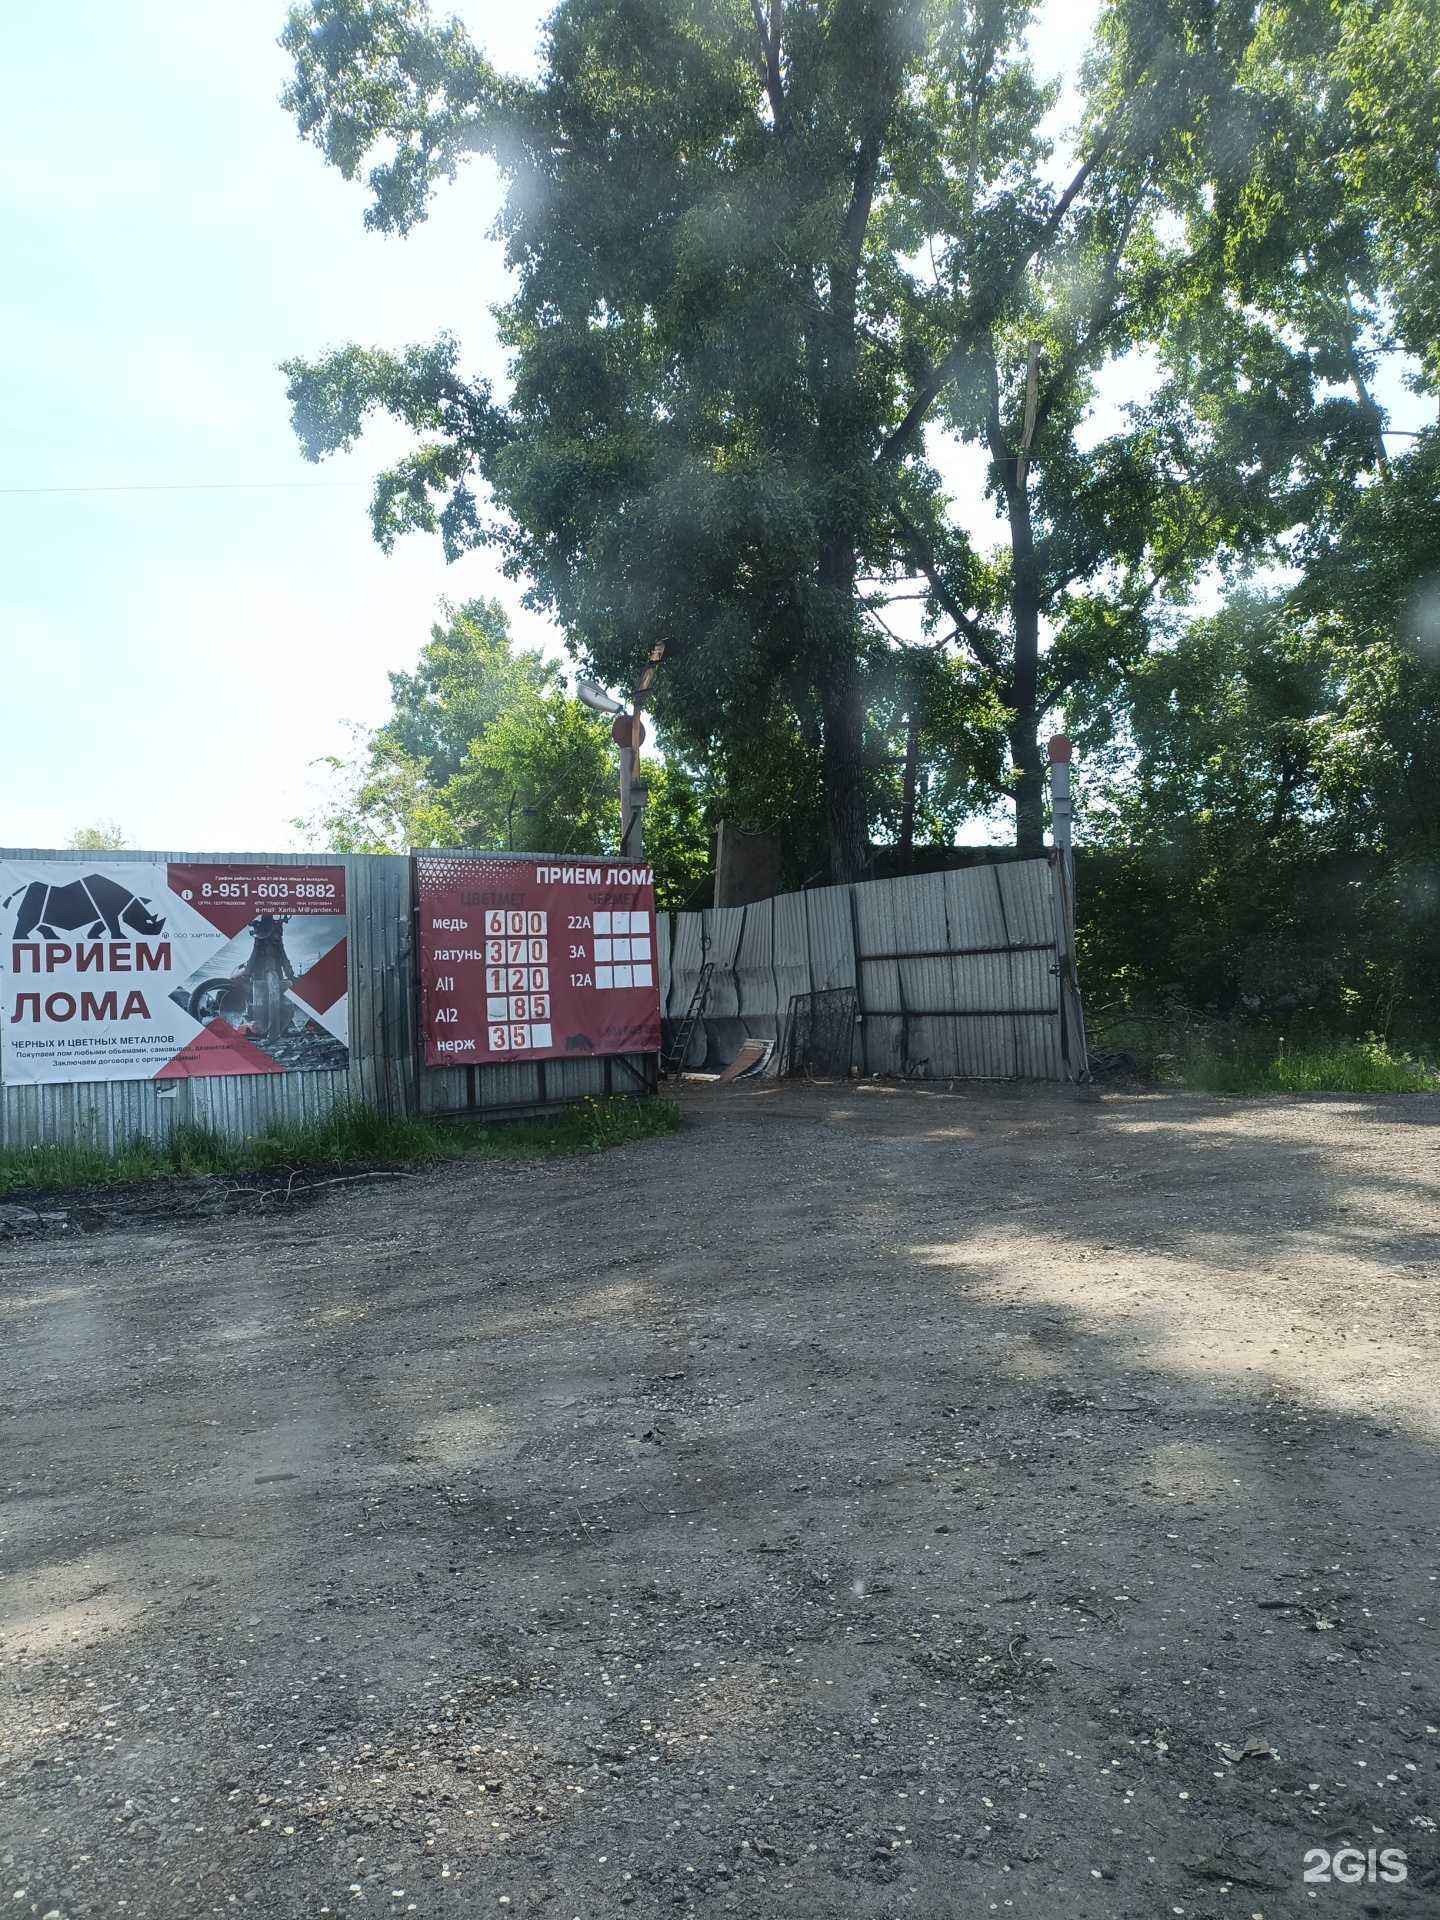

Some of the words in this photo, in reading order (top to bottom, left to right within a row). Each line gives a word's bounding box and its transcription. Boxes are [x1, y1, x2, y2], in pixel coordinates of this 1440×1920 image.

[536, 866, 601, 885] ПРИЕМ
[201, 883, 336, 898] 8-951-603-8882
[432, 918, 468, 932] медь
[490, 912, 542, 933] 600
[567, 916, 591, 929] 22А
[12, 942, 172, 973] ПРИЕМ
[433, 949, 482, 962] латунь
[490, 941, 543, 962] 370
[569, 945, 586, 958] 3А
[491, 969, 544, 991] 120
[569, 974, 592, 987] 12А
[11, 990, 152, 1023] ЛОМА
[514, 997, 546, 1018] 85
[11, 1039, 55, 1048] ЧЕРНЫХ
[57, 1039, 65, 1047] И
[67, 1038, 117, 1047] ЦВЕТНЫХ
[120, 1035, 174, 1044] МЕТАЛЛОВ
[437, 1040, 476, 1053] нерж
[493, 1026, 525, 1048] 35
[16, 1051, 54, 1059] Покупаем
